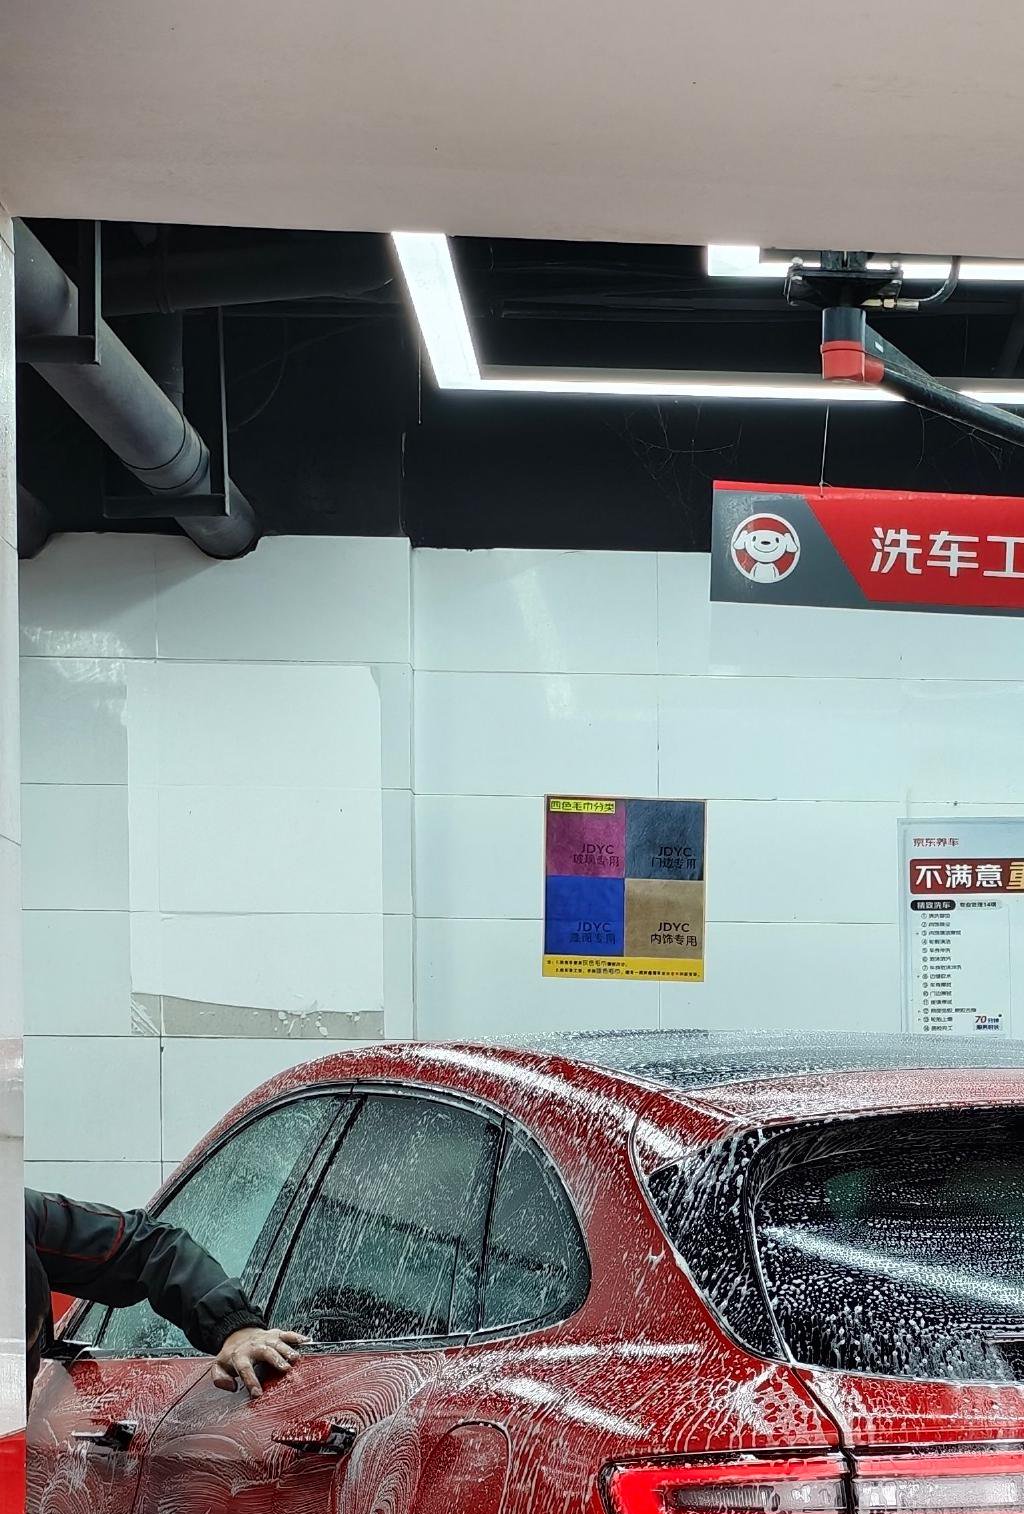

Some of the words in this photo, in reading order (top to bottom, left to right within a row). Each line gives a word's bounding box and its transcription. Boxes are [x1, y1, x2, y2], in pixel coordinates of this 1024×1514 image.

[550, 800, 615, 813] 四色毛巾分类
[912, 837, 960, 848] 京东养车
[581, 843, 615, 855] JDYC
[657, 846, 693, 858] JDYC
[577, 921, 612, 933] JDYC
[658, 921, 691, 933] JDYC
[650, 932, 698, 947] 内饰专用
